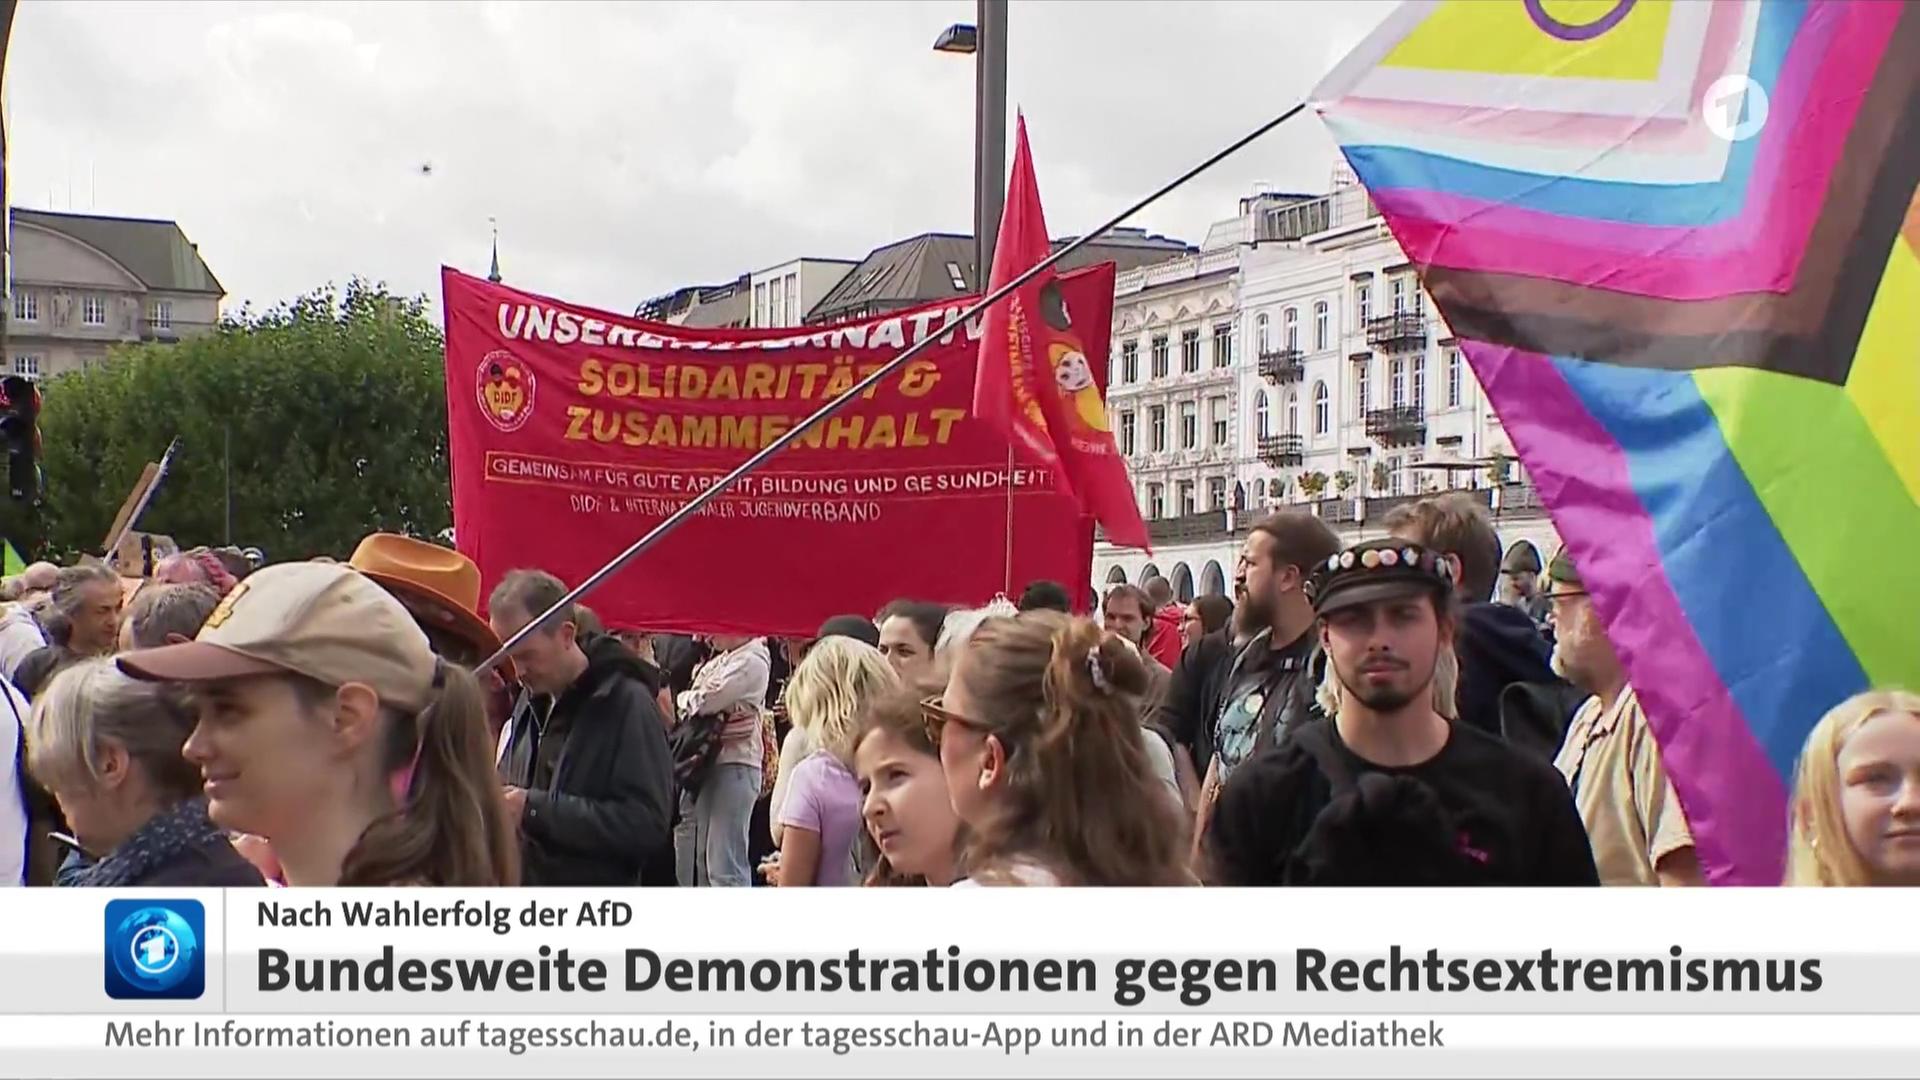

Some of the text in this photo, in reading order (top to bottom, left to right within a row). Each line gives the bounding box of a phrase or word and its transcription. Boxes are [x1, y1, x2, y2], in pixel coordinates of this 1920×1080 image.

[578, 355, 941, 400] SOLIDARITÄT &
[564, 405, 966, 449] ZUSAMMENHALT
[633, 472, 680, 490] GUTE
[762, 477, 848, 494] BILDUNG
[854, 476, 897, 493] UND
[625, 497, 736, 518] INTERNATNALER
[740, 501, 881, 523] JUGENDVERBAND
